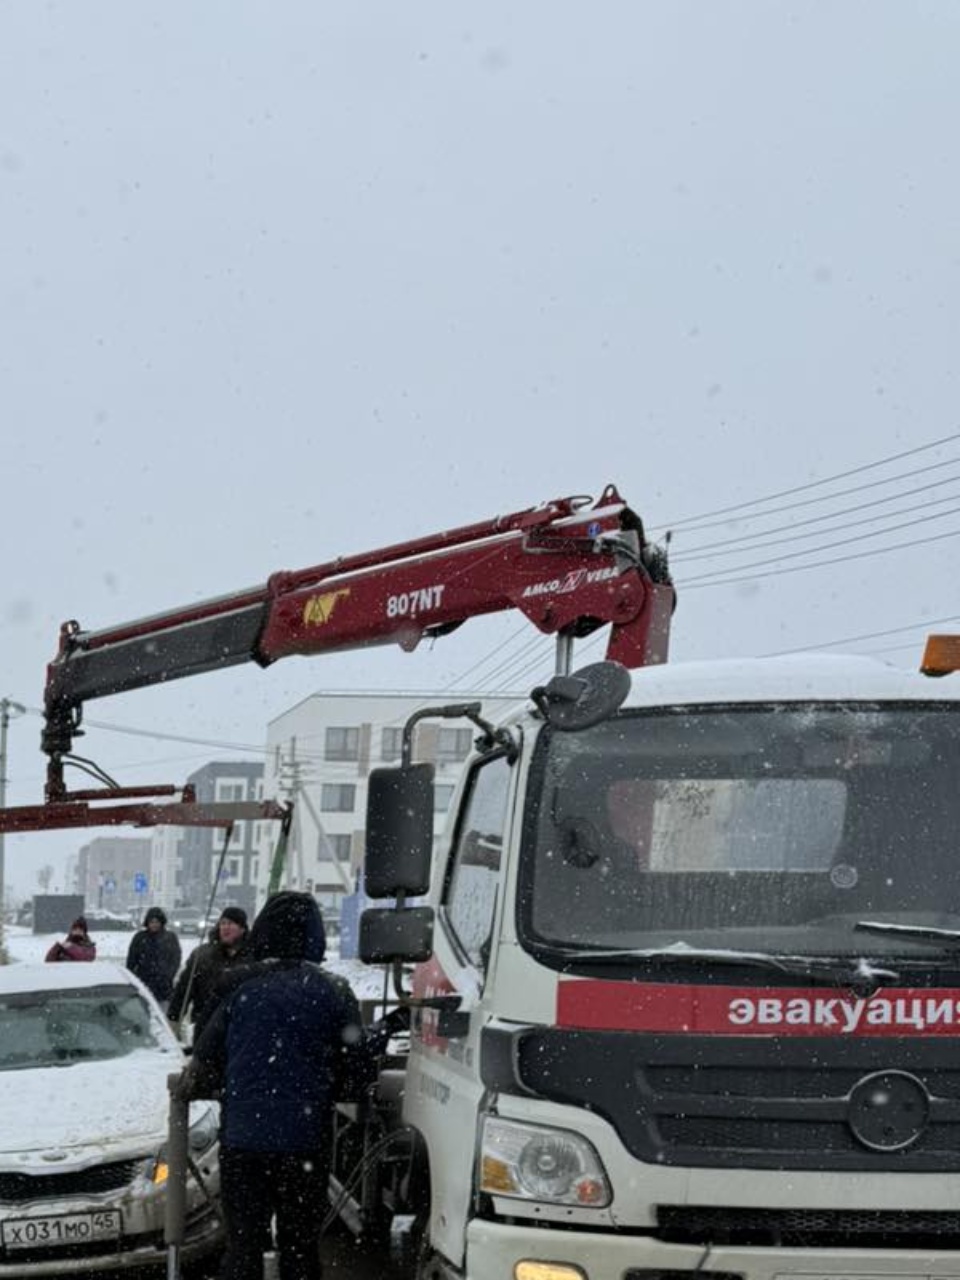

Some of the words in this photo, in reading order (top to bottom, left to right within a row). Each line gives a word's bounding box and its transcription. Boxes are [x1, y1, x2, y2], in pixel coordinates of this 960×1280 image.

[387, 585, 445, 617] 807NT
[522, 580, 560, 598] AMCO
[728, 998, 960, 1032] эвакуаци
